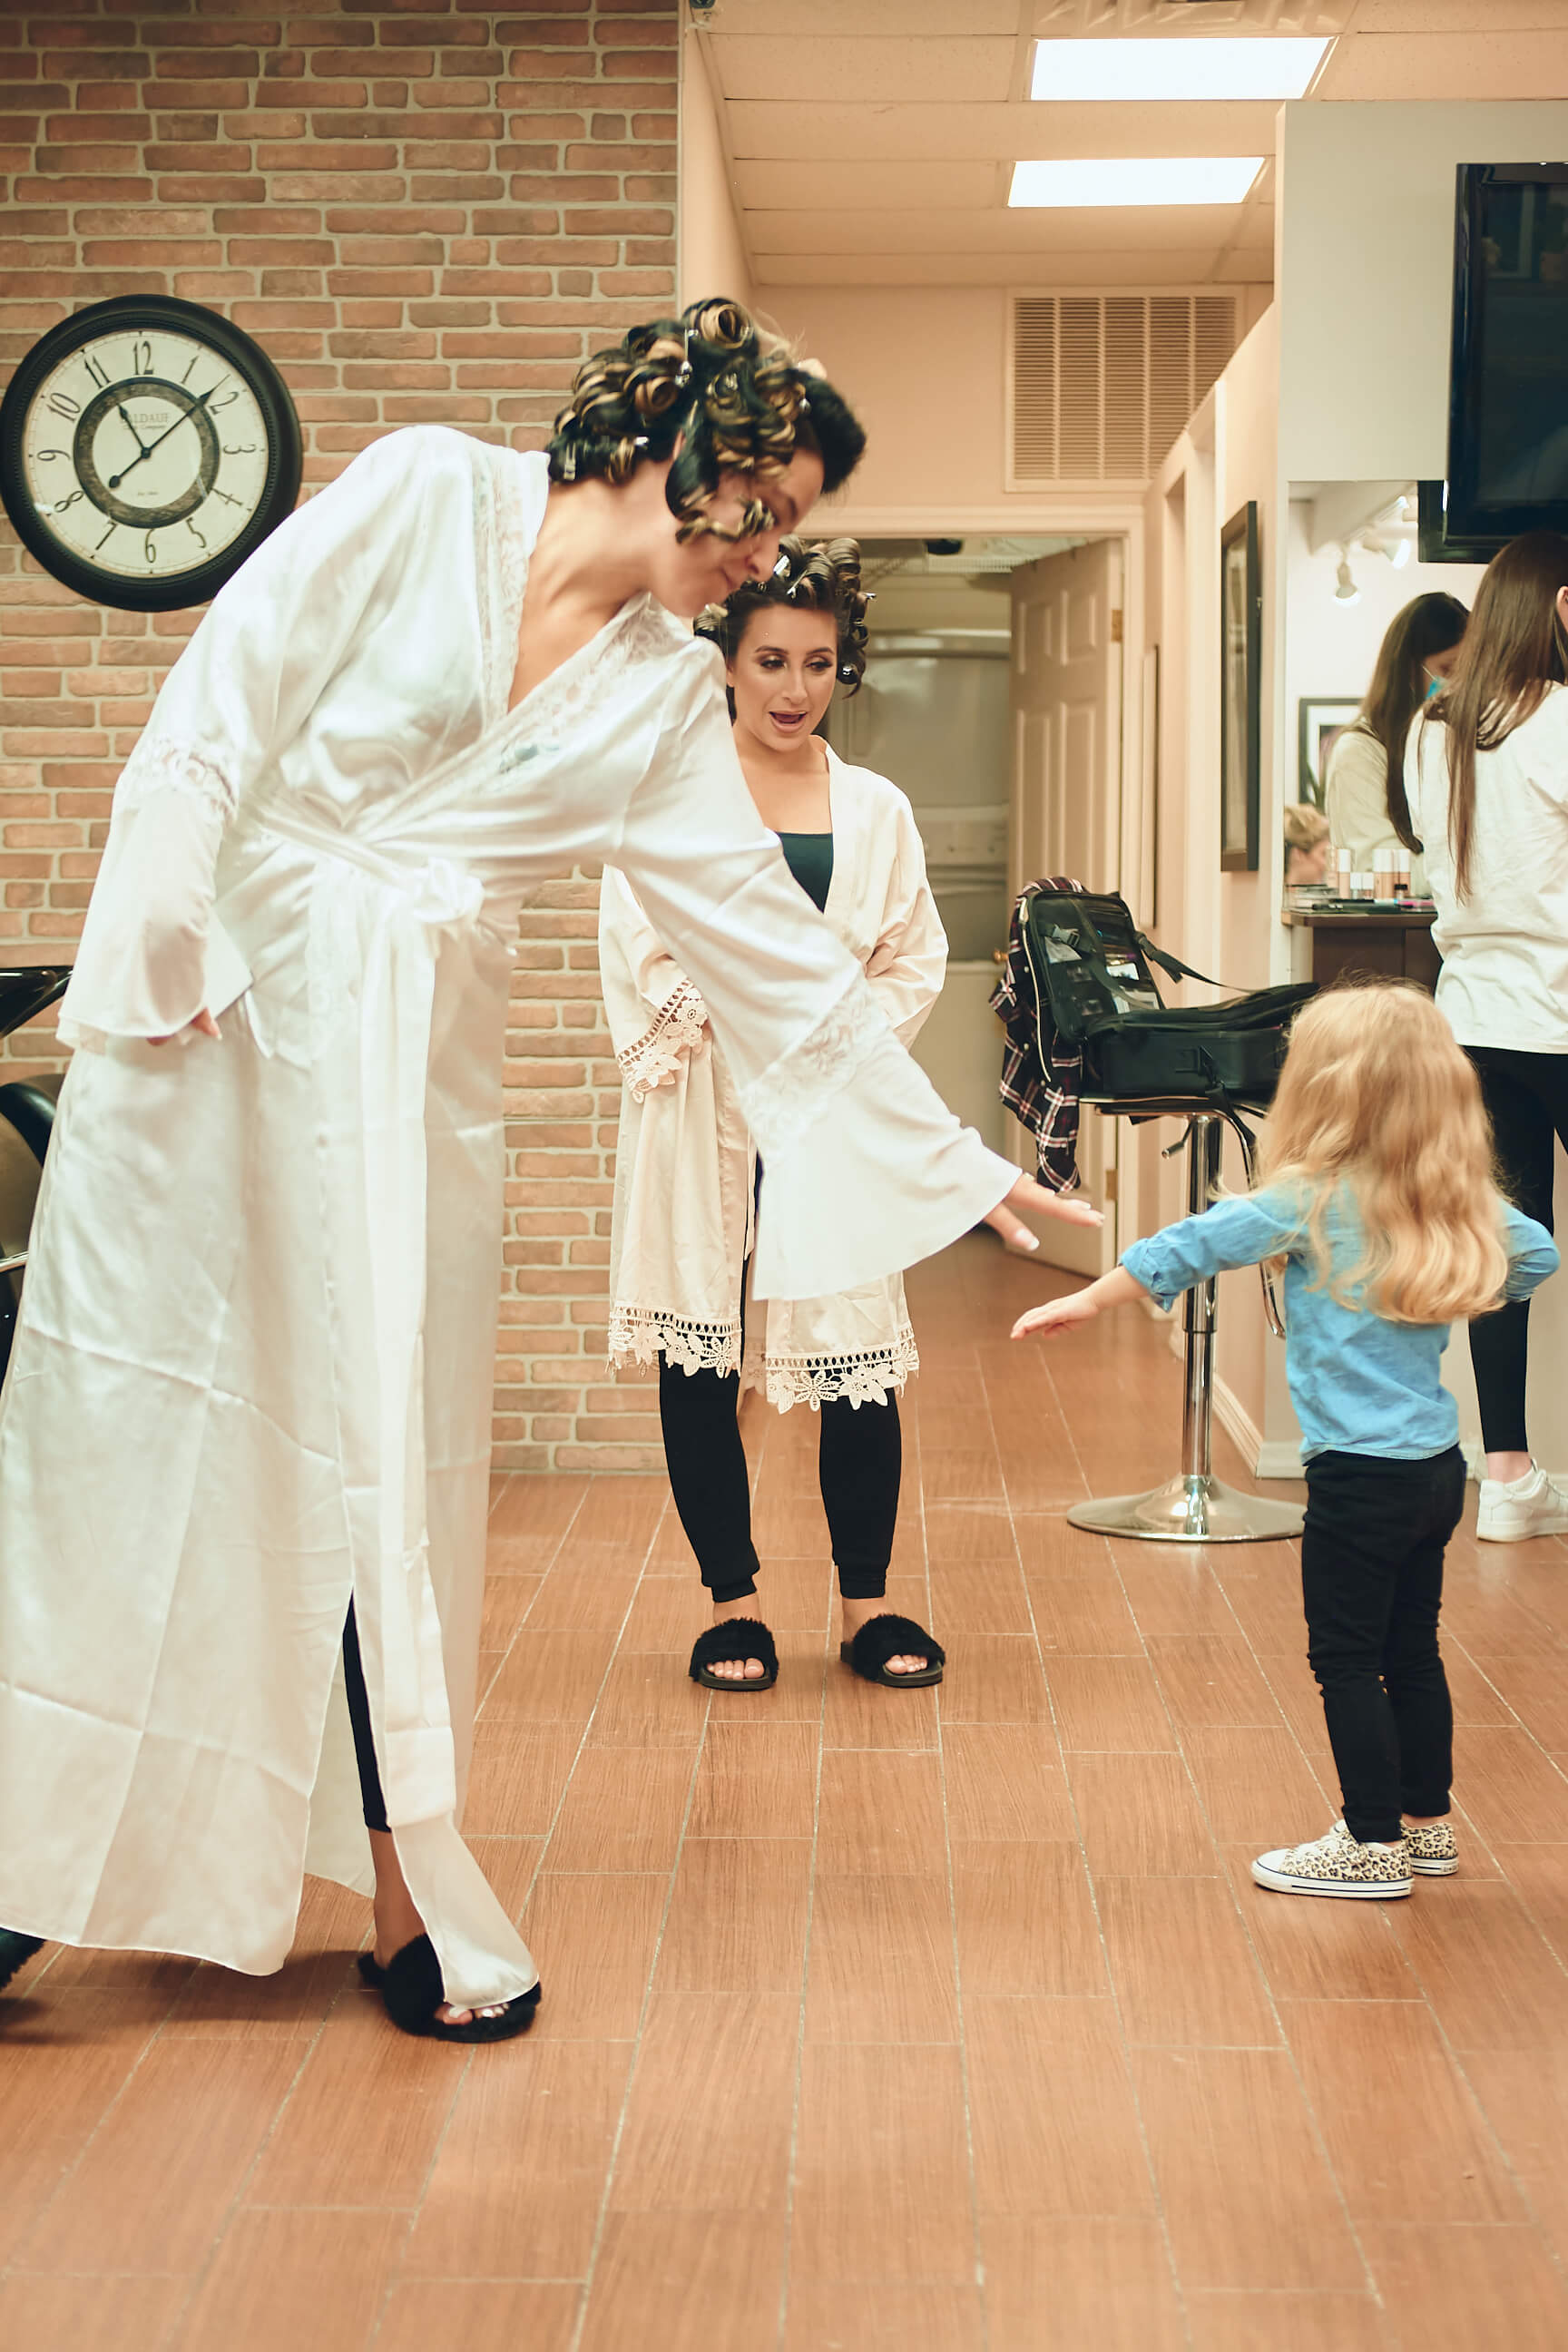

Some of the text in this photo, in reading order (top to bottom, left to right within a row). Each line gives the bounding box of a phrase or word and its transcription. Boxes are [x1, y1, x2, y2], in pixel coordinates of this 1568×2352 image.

[83, 355, 112, 388] 11
[132, 340, 153, 375] 12
[181, 356, 199, 385] 1
[46, 392, 81, 422] 10
[210, 391, 240, 415] 2
[36, 449, 71, 461] 9
[222, 444, 257, 455] 3
[54, 490, 84, 513] 8
[211, 487, 242, 505] 4
[95, 520, 118, 550] 7
[144, 528, 156, 564] 6
[186, 516, 207, 548] 5
